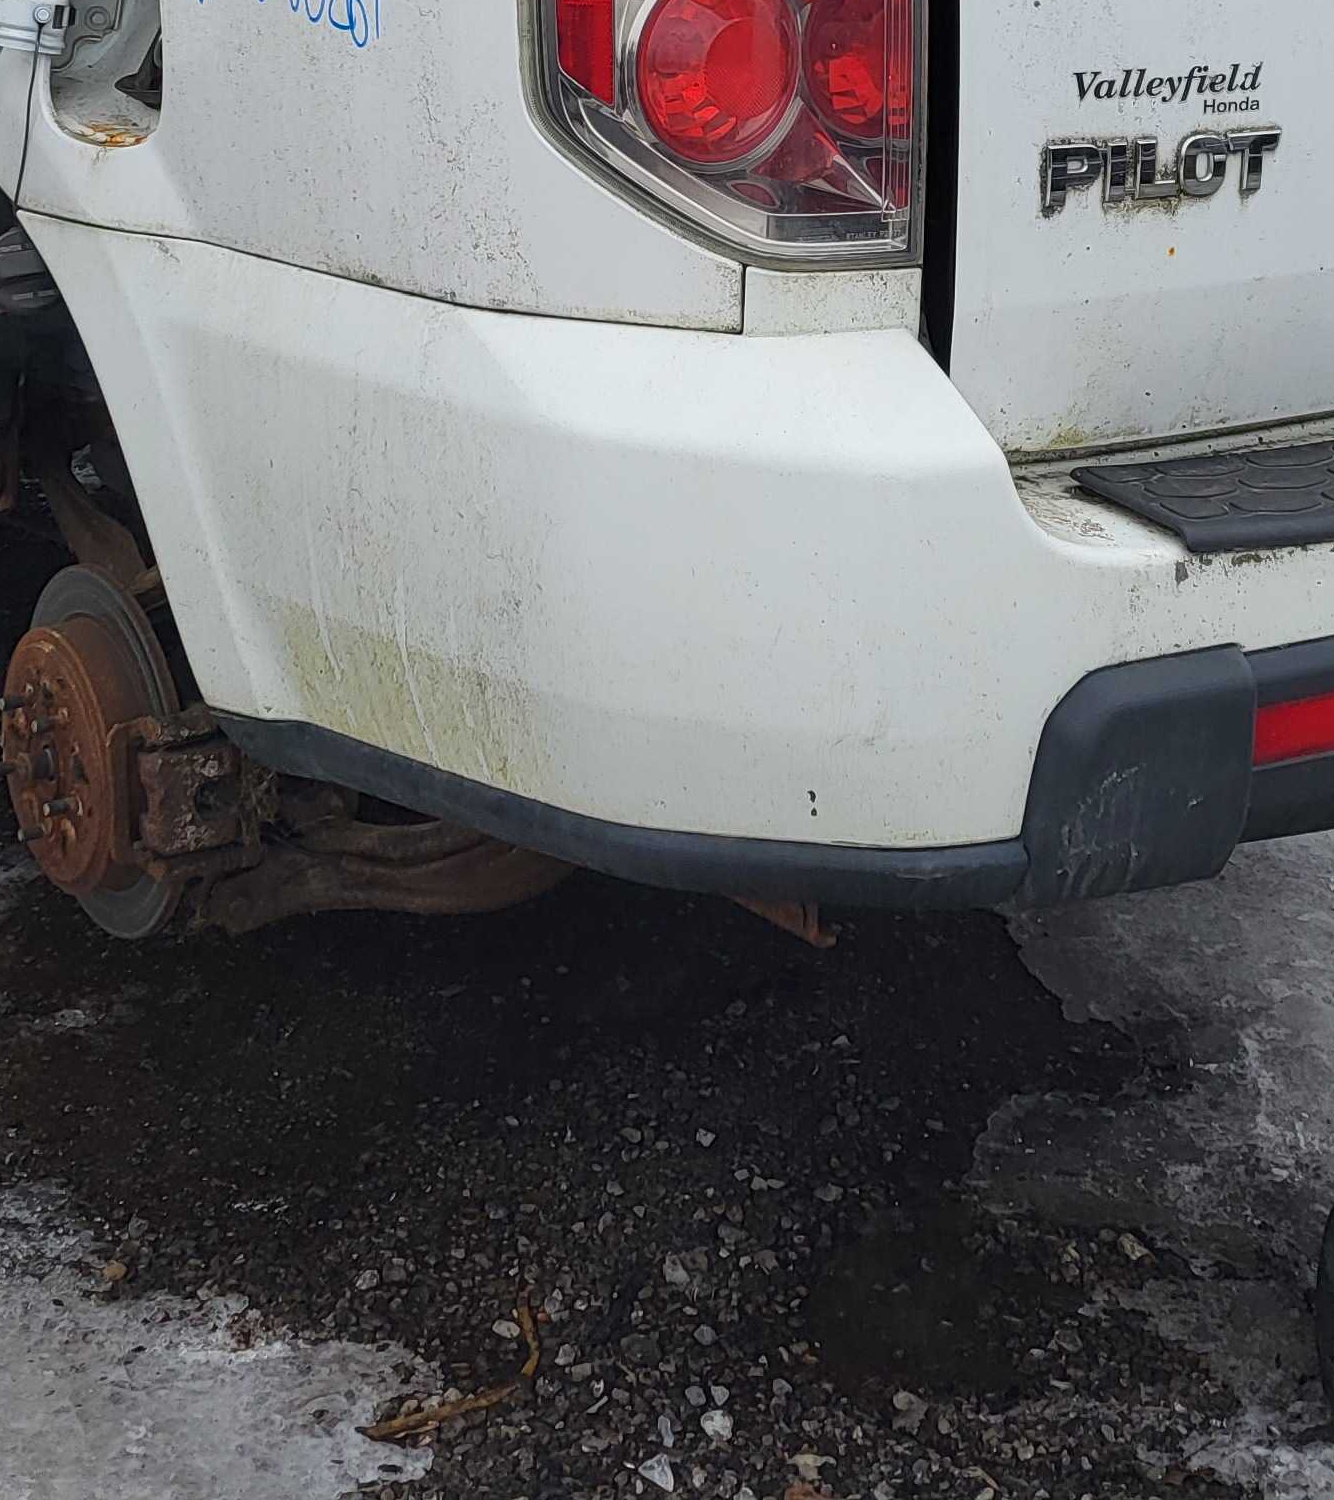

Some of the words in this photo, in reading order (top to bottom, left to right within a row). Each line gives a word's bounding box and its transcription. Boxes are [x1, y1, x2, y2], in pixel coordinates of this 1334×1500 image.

[1072, 61, 1264, 102] Valleyfield
[1203, 97, 1260, 114] Honda
[1041, 127, 1282, 209] PILOT
